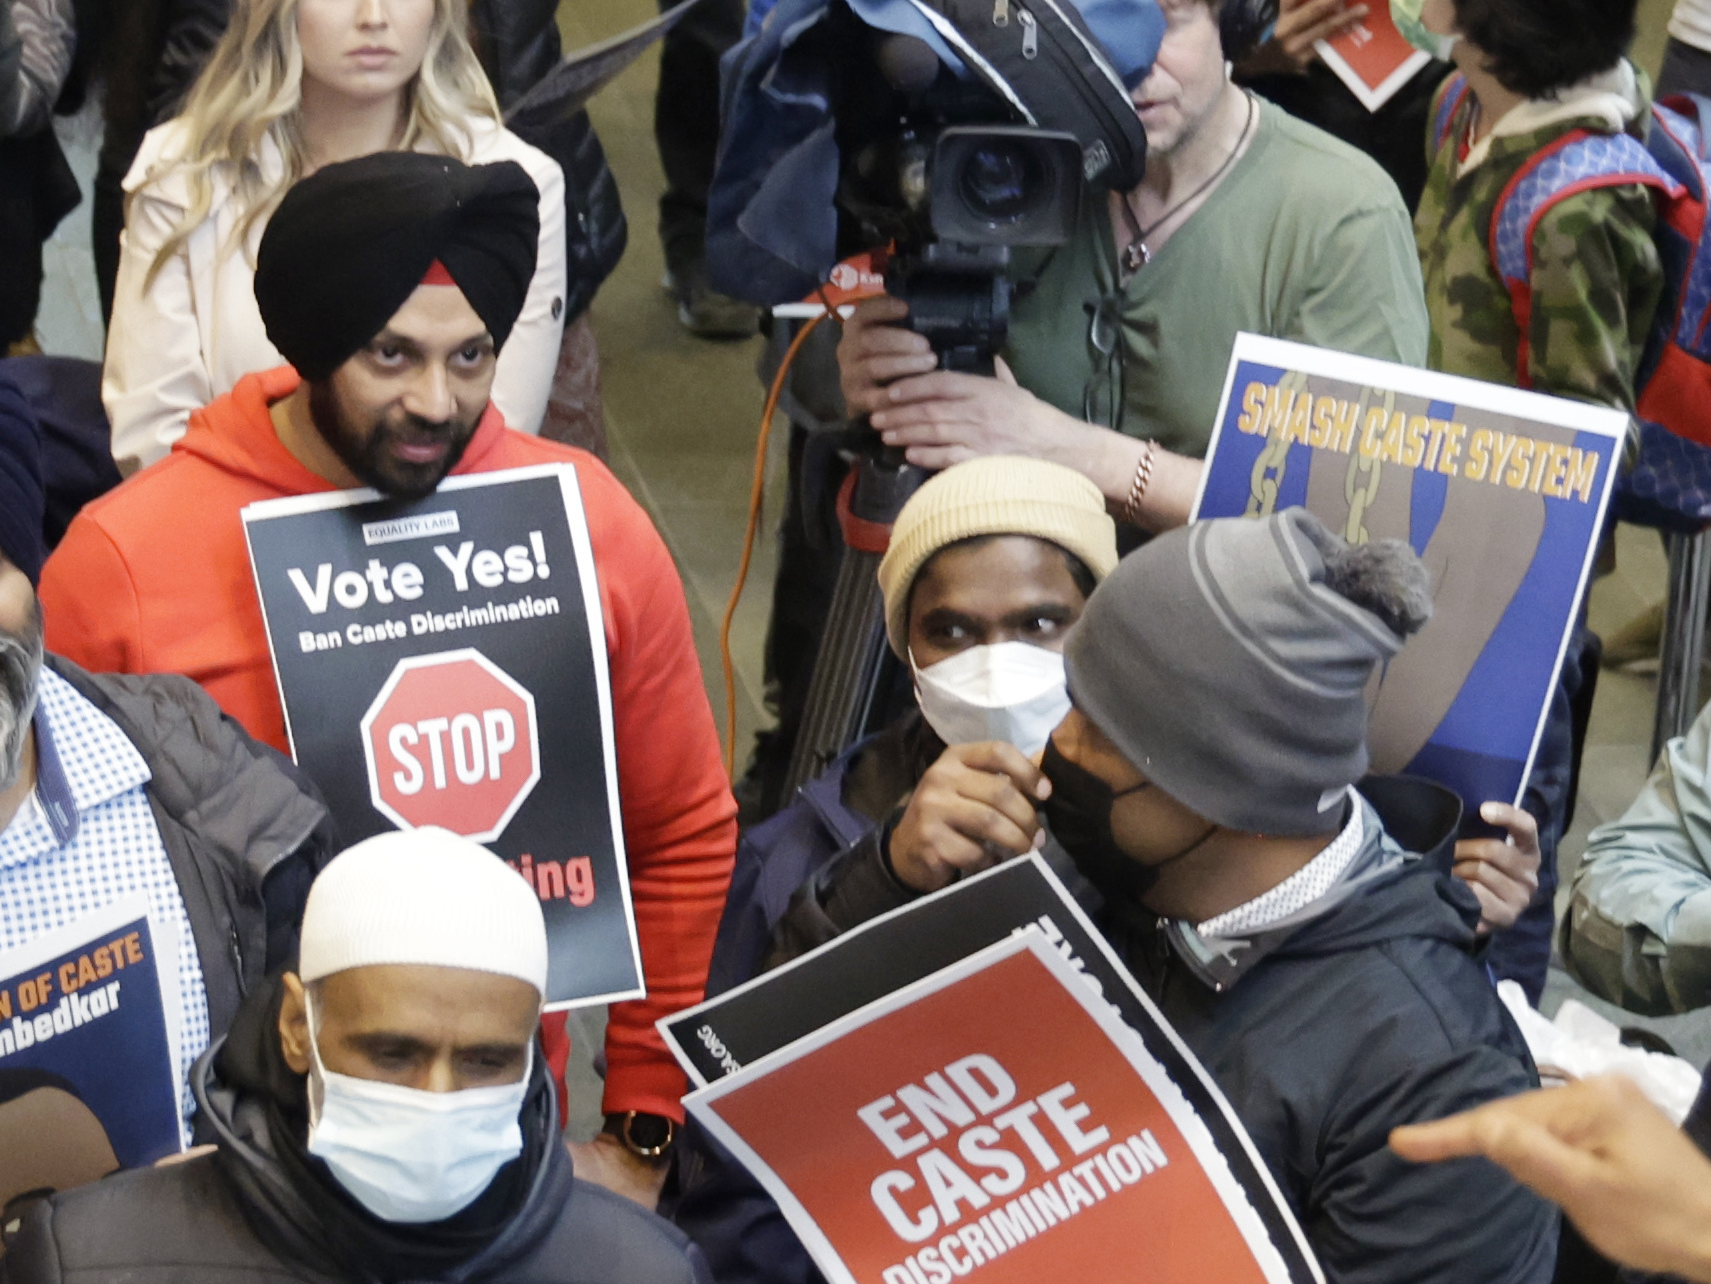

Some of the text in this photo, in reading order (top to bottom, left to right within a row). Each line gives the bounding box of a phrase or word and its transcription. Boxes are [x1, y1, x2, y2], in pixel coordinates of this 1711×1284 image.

[1238, 381, 1600, 504] SMASH CASTE SYSTEM
[288, 530, 551, 615] Vote Yes!
[367, 518, 421, 540] EQUALITY
[299, 595, 561, 653] Ban Caste Discrimination
[388, 707, 517, 796] STOP
[16, 972, 52, 1013] OF
[58, 931, 144, 996] CASTE
[857, 1052, 1019, 1160] END
[869, 1080, 1112, 1243] CASTE
